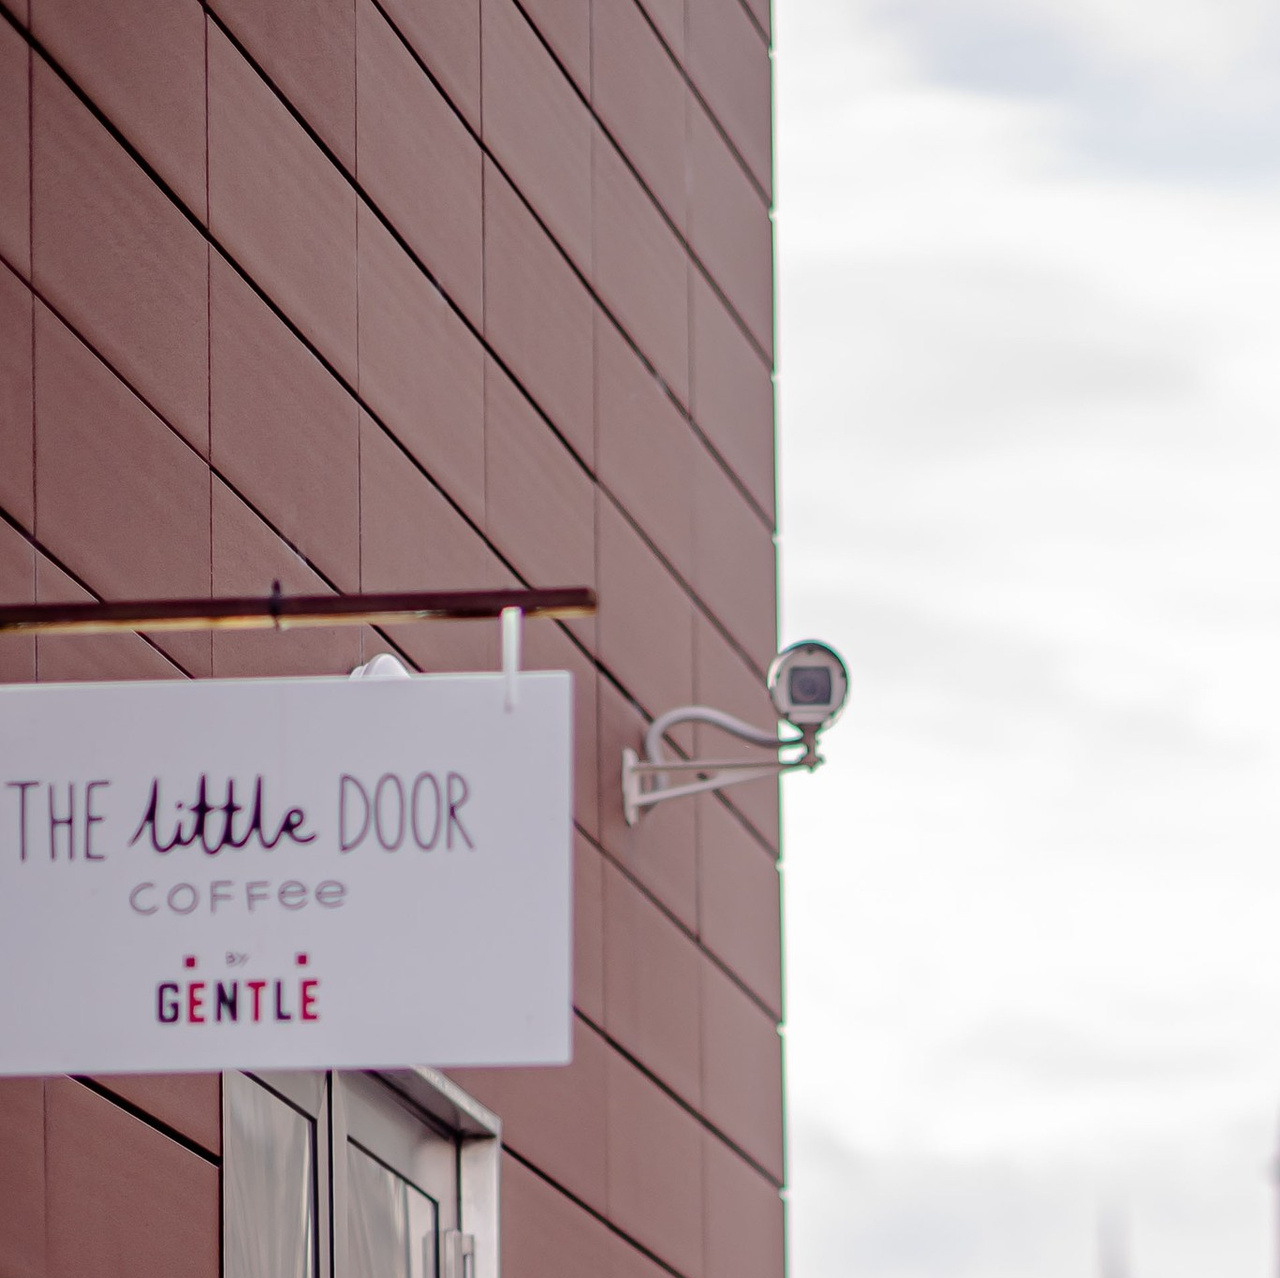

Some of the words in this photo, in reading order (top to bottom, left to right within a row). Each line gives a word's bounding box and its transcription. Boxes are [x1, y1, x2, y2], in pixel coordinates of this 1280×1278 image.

[5, 780, 112, 863] THE
[127, 772, 320, 858] little
[338, 771, 476, 855] DOOR
[155, 977, 321, 1026] GENTLE
